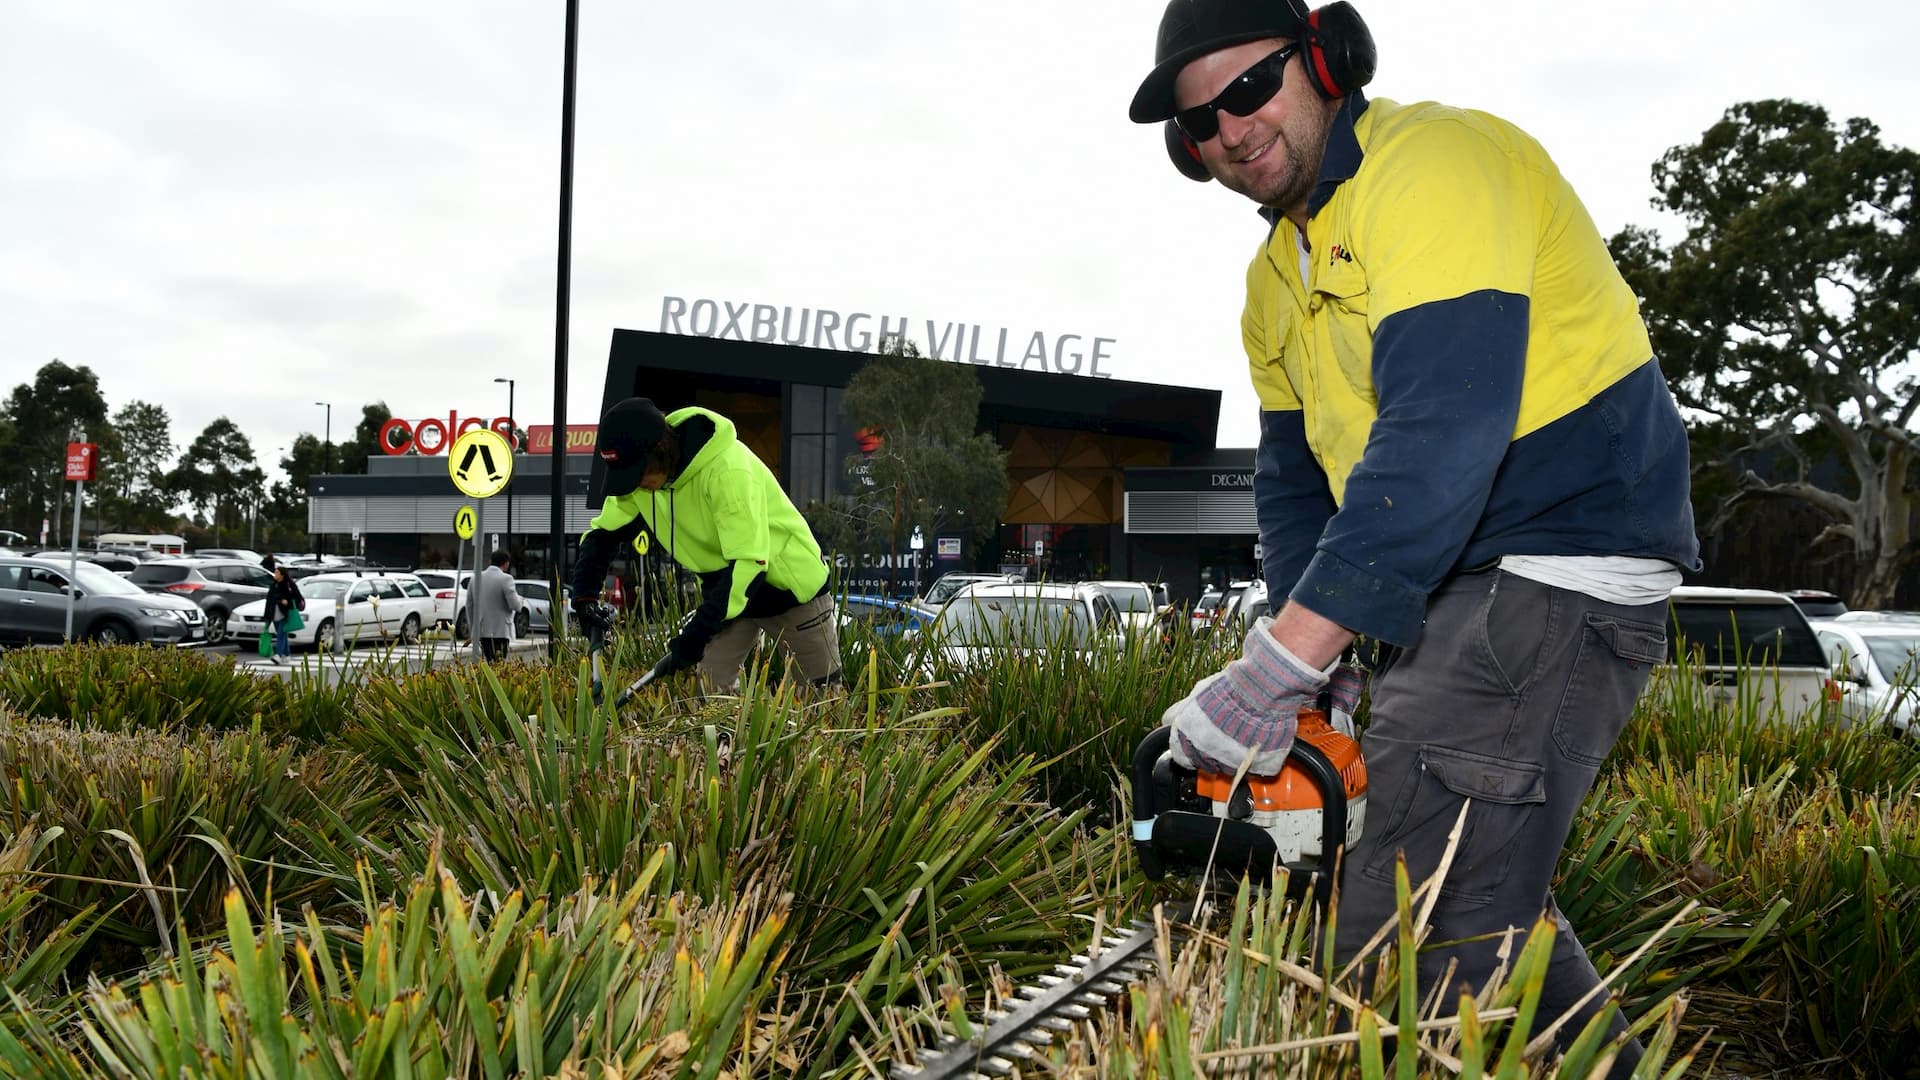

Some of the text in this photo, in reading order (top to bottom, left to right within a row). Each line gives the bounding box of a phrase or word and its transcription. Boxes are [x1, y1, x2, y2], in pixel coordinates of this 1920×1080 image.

[660, 296, 1117, 378] ROXBURGH VILLAGE
[897, 579, 922, 587] ARK
